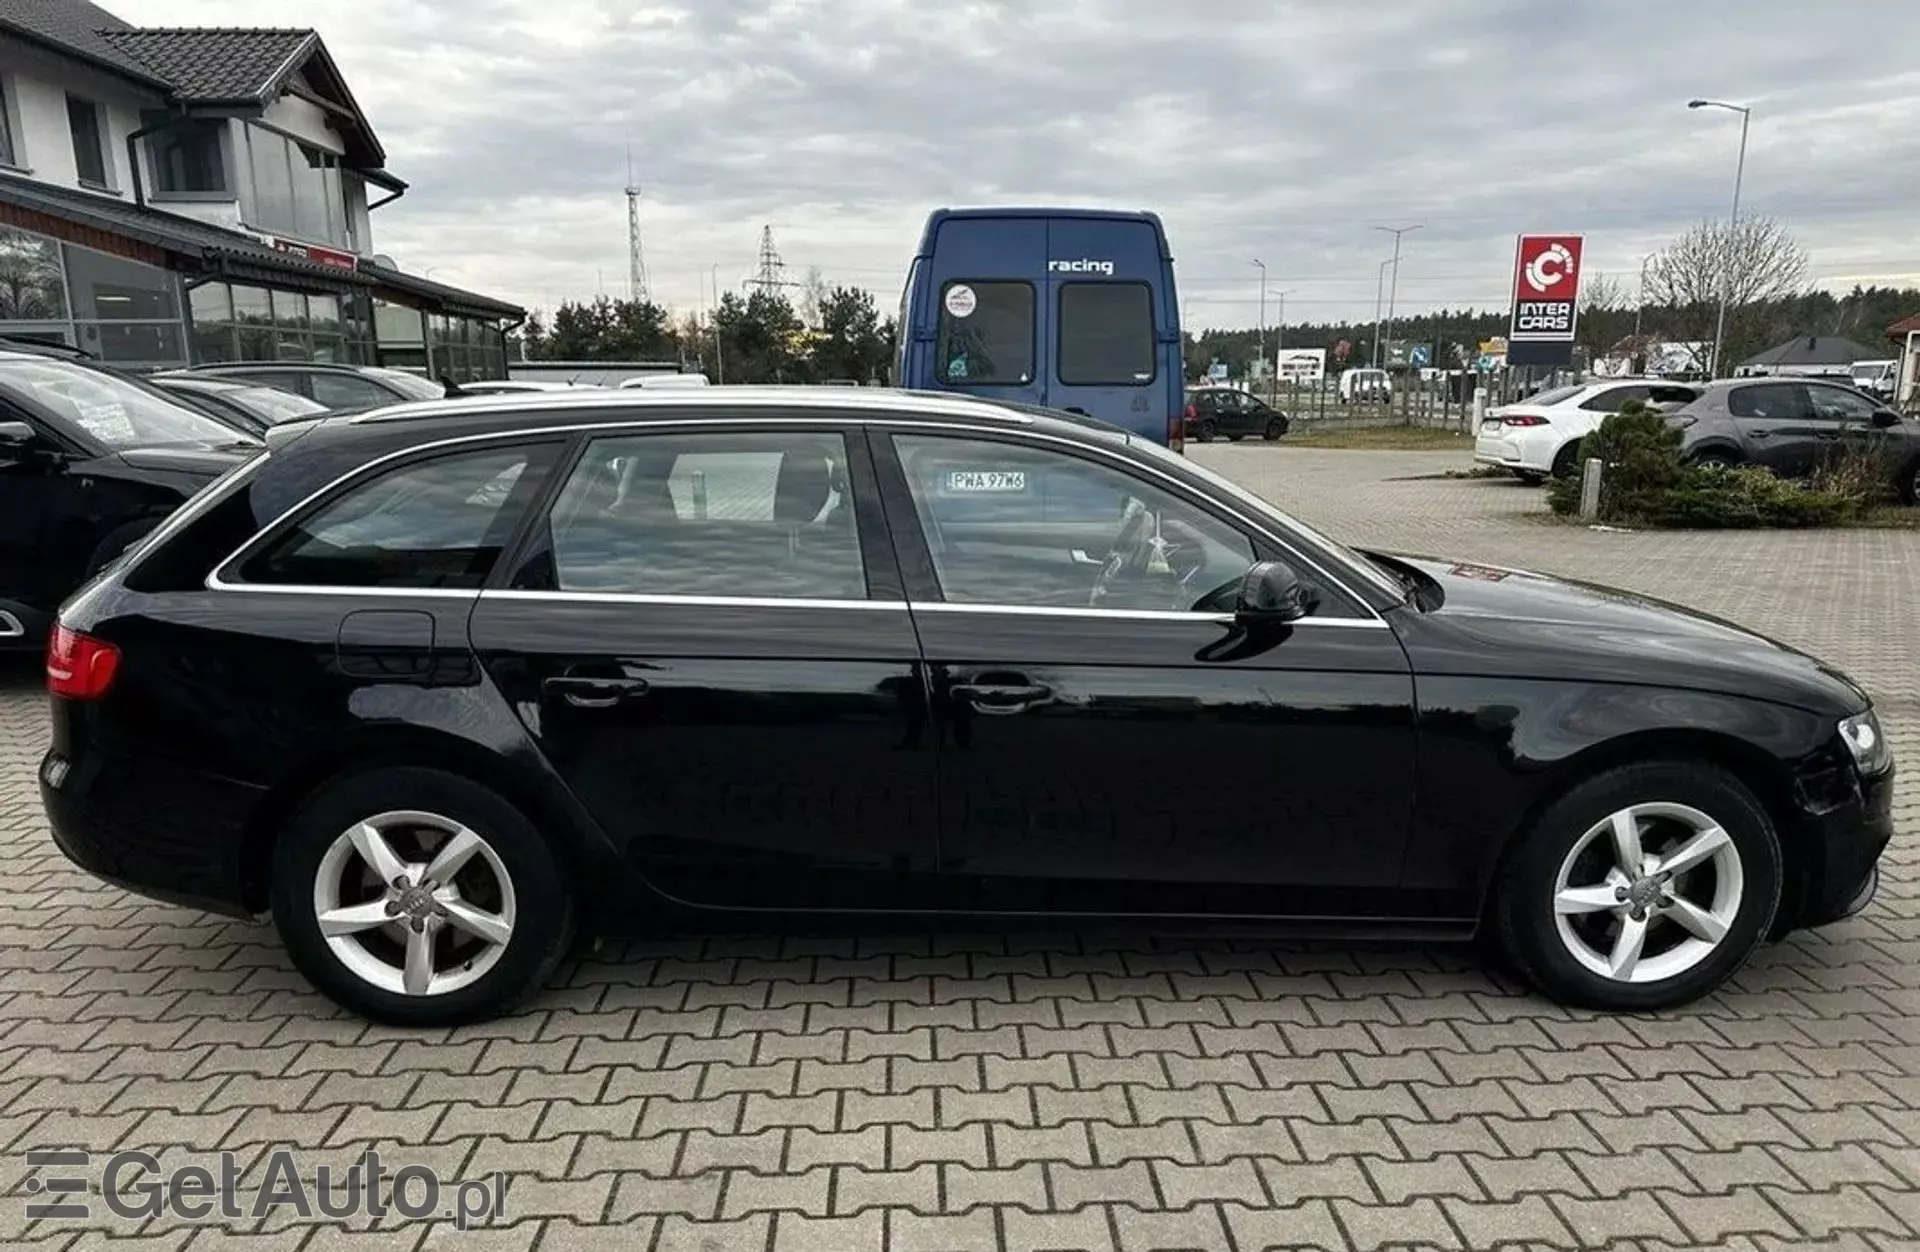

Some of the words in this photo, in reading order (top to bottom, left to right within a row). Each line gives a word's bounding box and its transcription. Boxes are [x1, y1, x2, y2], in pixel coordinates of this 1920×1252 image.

[1048, 258, 1114, 275] racing
[1520, 302, 1570, 315] INTER
[1519, 316, 1568, 329] CARS
